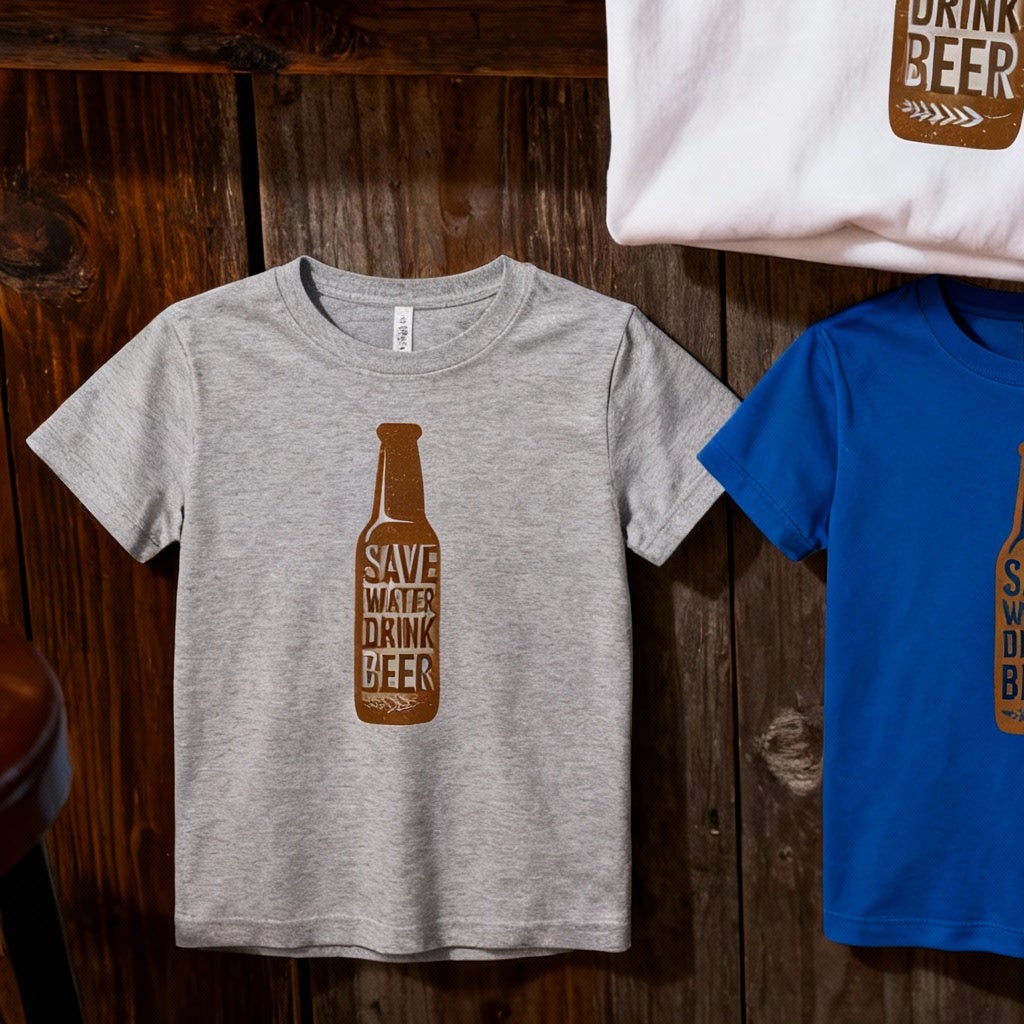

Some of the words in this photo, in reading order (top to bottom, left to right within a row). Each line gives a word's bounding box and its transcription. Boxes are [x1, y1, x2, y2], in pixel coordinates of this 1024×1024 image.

[905, 31, 1018, 99] BEER
[364, 543, 438, 584] SAVE
[365, 587, 435, 614] WATER
[363, 616, 435, 649] DRINK
[362, 650, 435, 693] BEER
